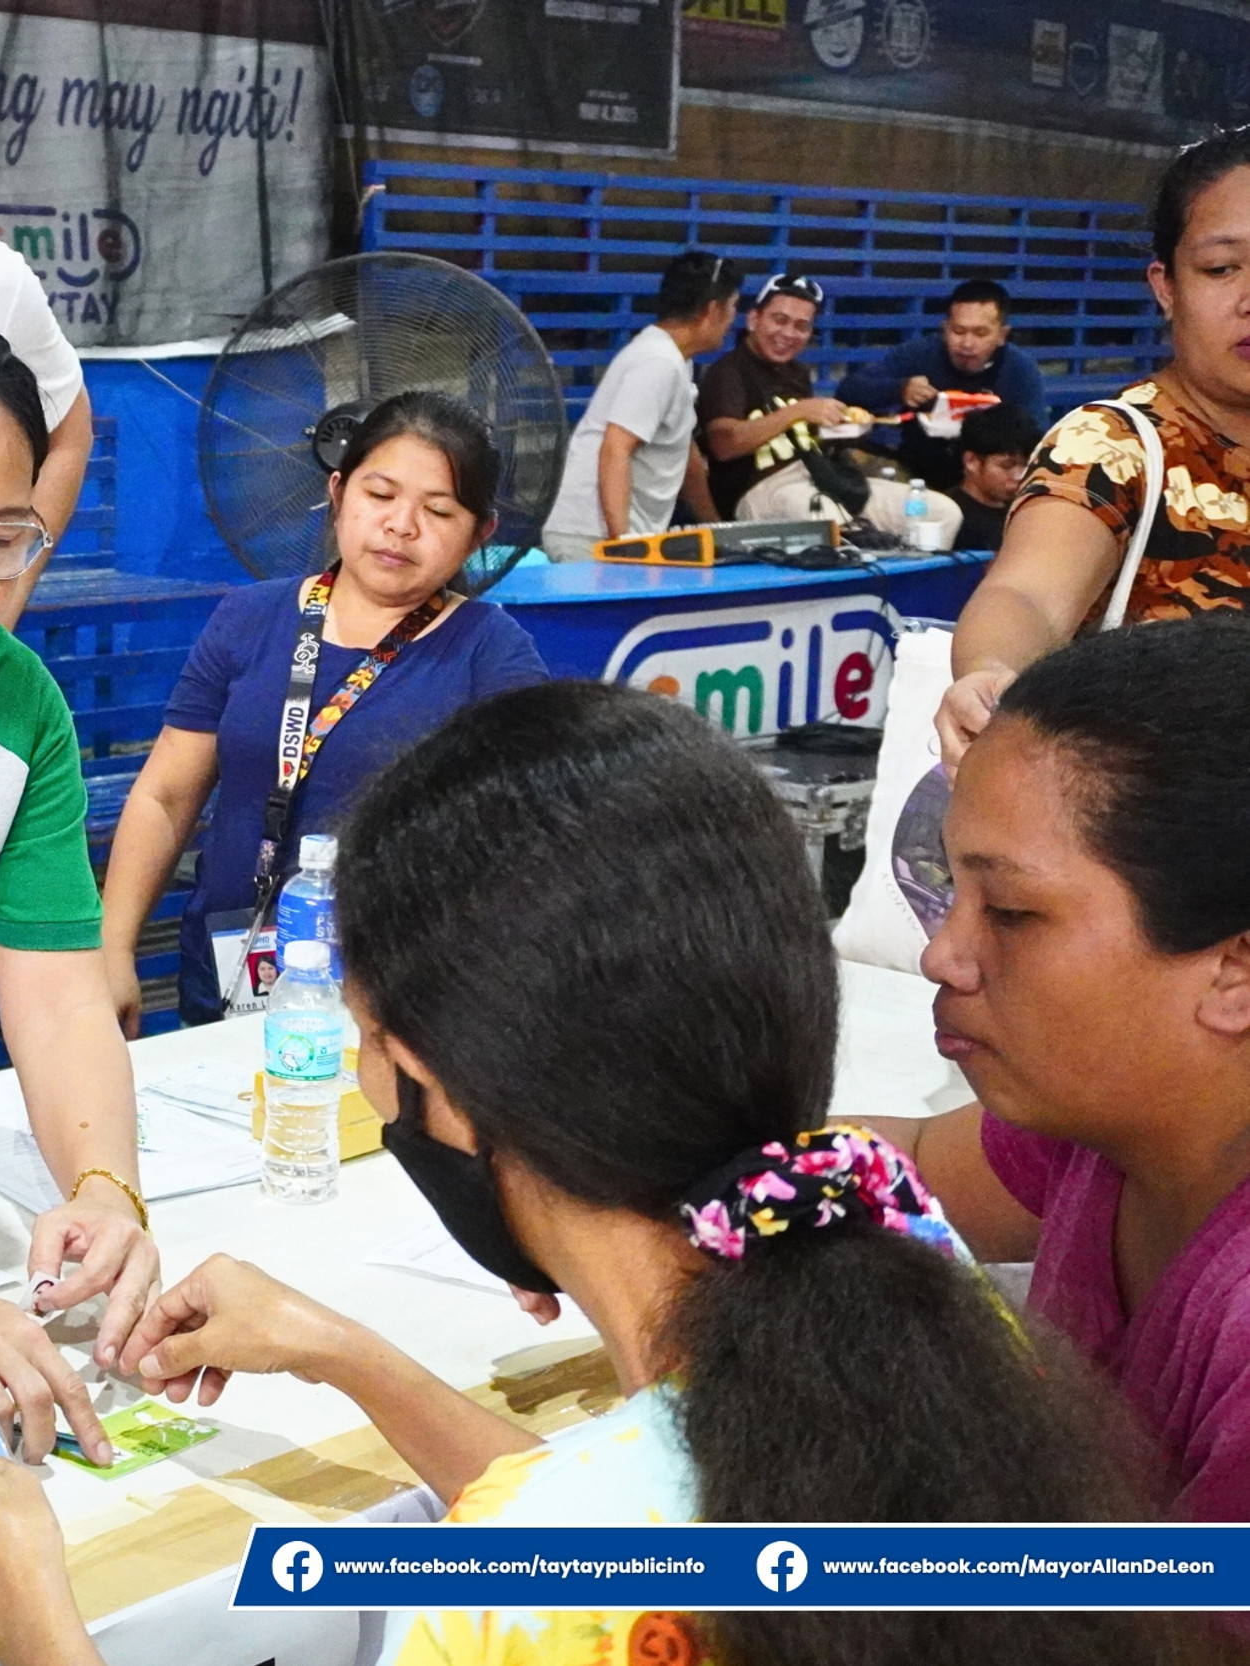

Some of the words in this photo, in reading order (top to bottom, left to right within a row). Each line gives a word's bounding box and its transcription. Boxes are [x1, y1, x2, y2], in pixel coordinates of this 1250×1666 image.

[57, 75, 164, 173] may
[176, 66, 304, 176] ngiti!
[282, 706, 305, 758] DSWD
